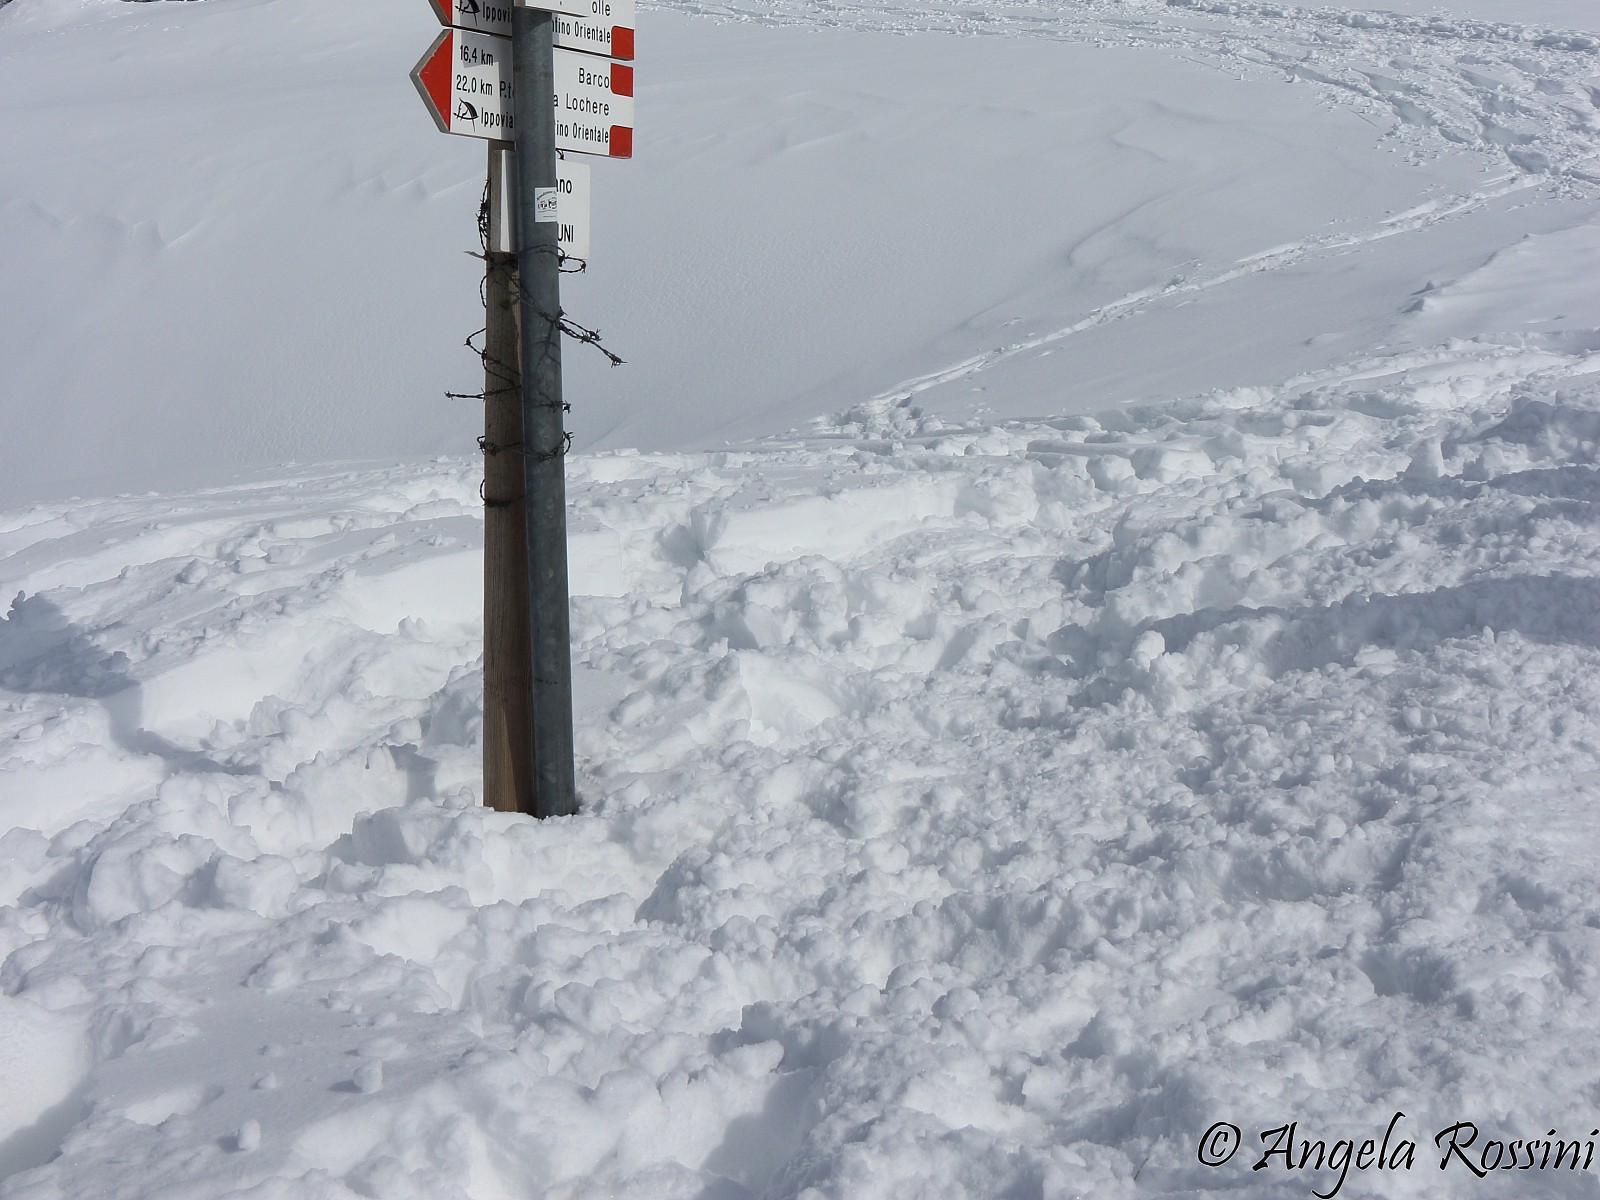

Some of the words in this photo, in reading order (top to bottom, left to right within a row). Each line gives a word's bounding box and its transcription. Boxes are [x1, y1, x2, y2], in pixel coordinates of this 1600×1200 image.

[482, 1, 512, 24] Ippovi
[575, 21, 611, 44] Orientale
[592, 0, 611, 17] olle
[460, 44, 478, 64] 16,4
[481, 49, 494, 66] km
[578, 67, 610, 89] Barco
[456, 74, 477, 93] 22,0
[480, 78, 493, 96] km
[566, 92, 610, 116] Lochere
[481, 106, 514, 129] Ippovia
[556, 120, 569, 138] ino
[573, 122, 609, 144] Orientale
[558, 223, 574, 243] UNI
